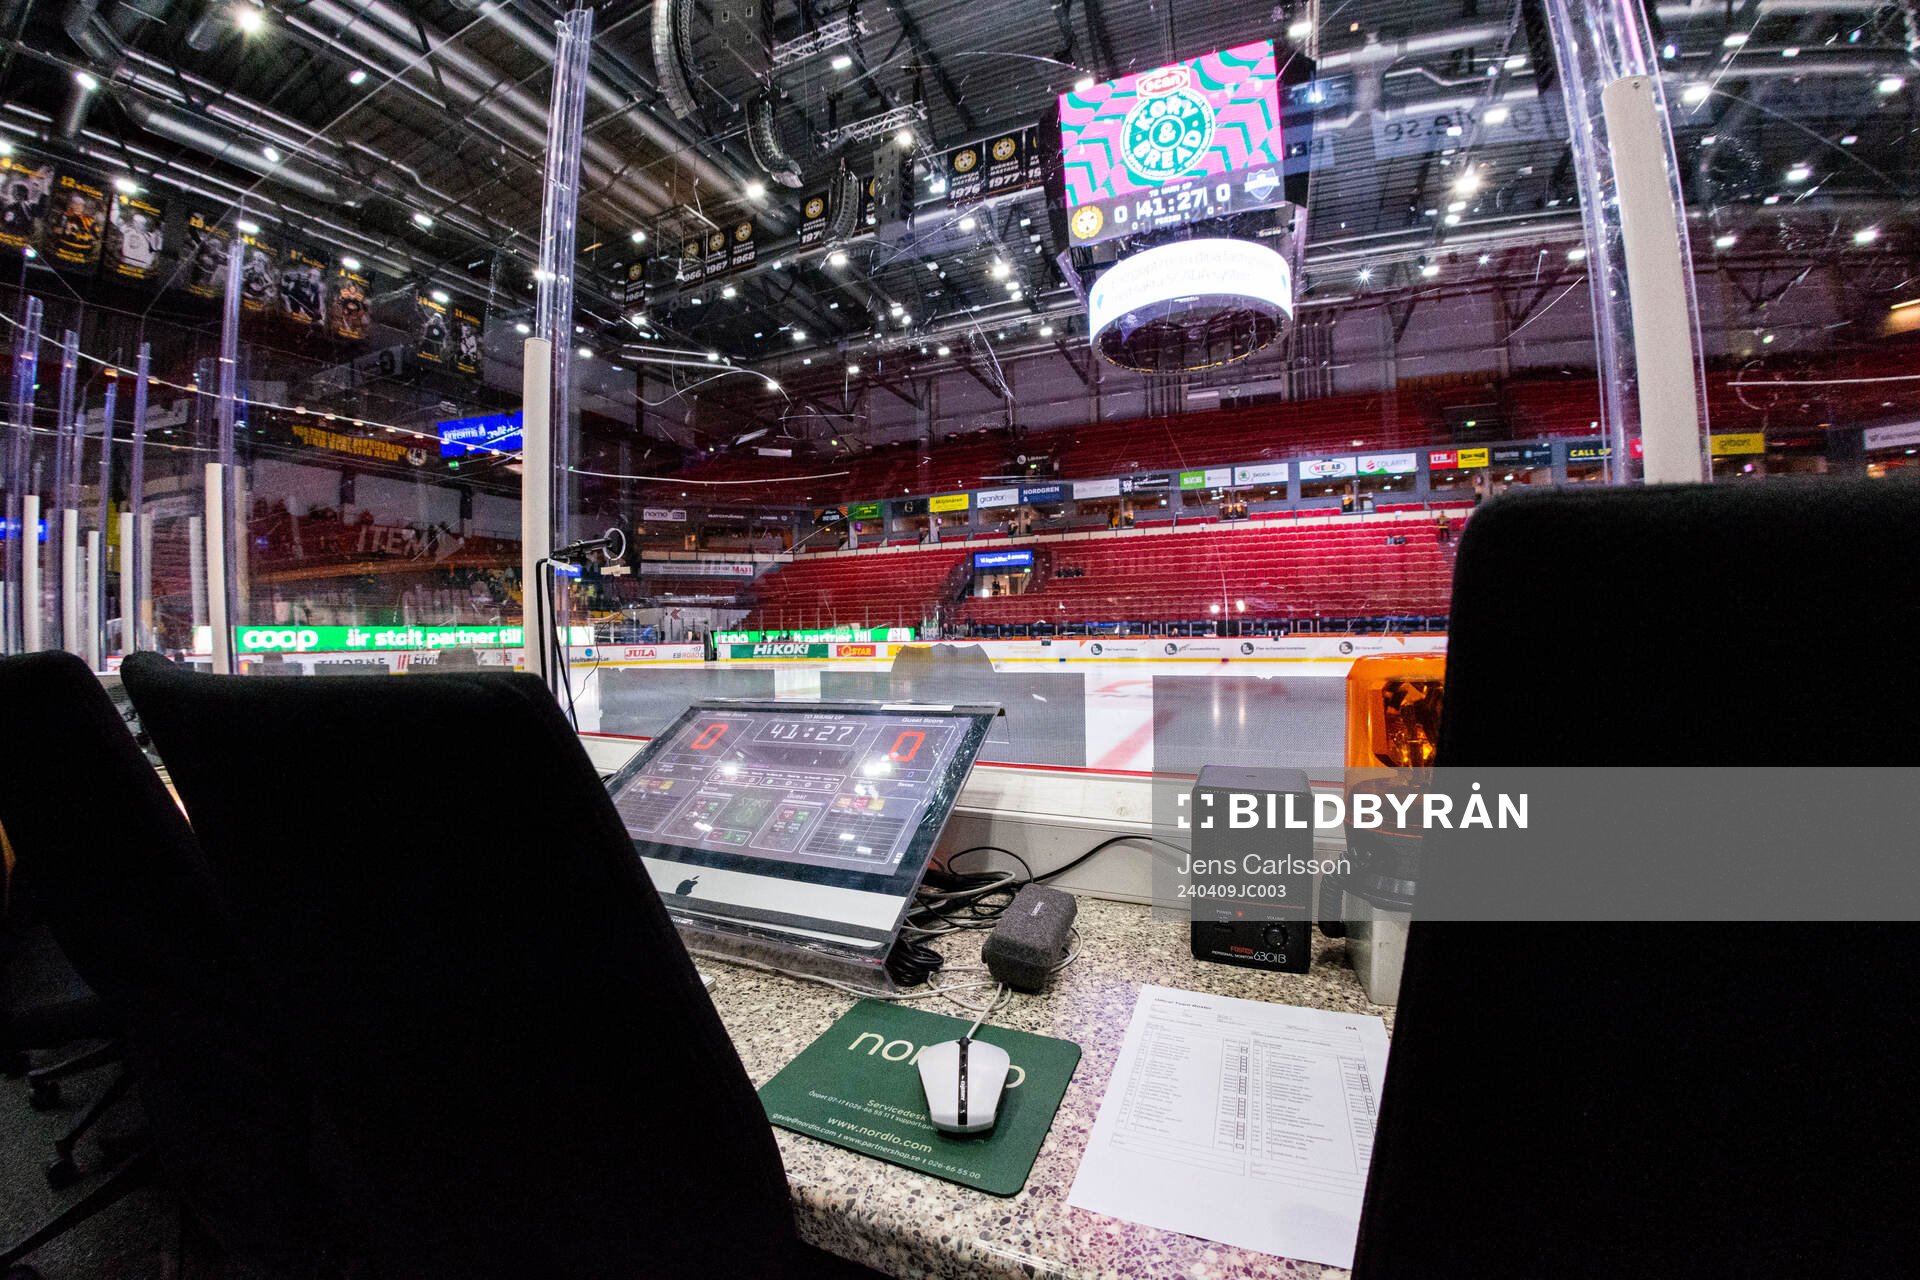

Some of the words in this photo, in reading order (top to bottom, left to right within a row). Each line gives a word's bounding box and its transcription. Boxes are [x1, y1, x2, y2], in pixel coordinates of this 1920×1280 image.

[1158, 122, 1176, 143] &
[1133, 129, 1202, 169] BREAD
[989, 172, 1020, 188] 1977
[1114, 206, 1128, 224] 0
[1139, 188, 1204, 216] 41:27
[1216, 184, 1230, 202] 0
[706, 261, 728, 275] 1967
[732, 251, 756, 266] 1968
[1570, 449, 1595, 457] CALL
[1022, 486, 1060, 496] NORDGREN
[242, 629, 319, 651] coop
[345, 629, 370, 647] är
[374, 629, 423, 647] stolt
[425, 630, 497, 649] partner
[500, 628, 522, 645] till
[625, 649, 655, 657] JULA
[690, 723, 729, 750] 0
[770, 724, 855, 742] 41:27
[888, 731, 926, 762] 0
[867, 1099, 928, 1122] Servicedesk
[827, 1116, 933, 1154] www.nordlo.com
[842, 1134, 921, 1163] www.partnershop.se
